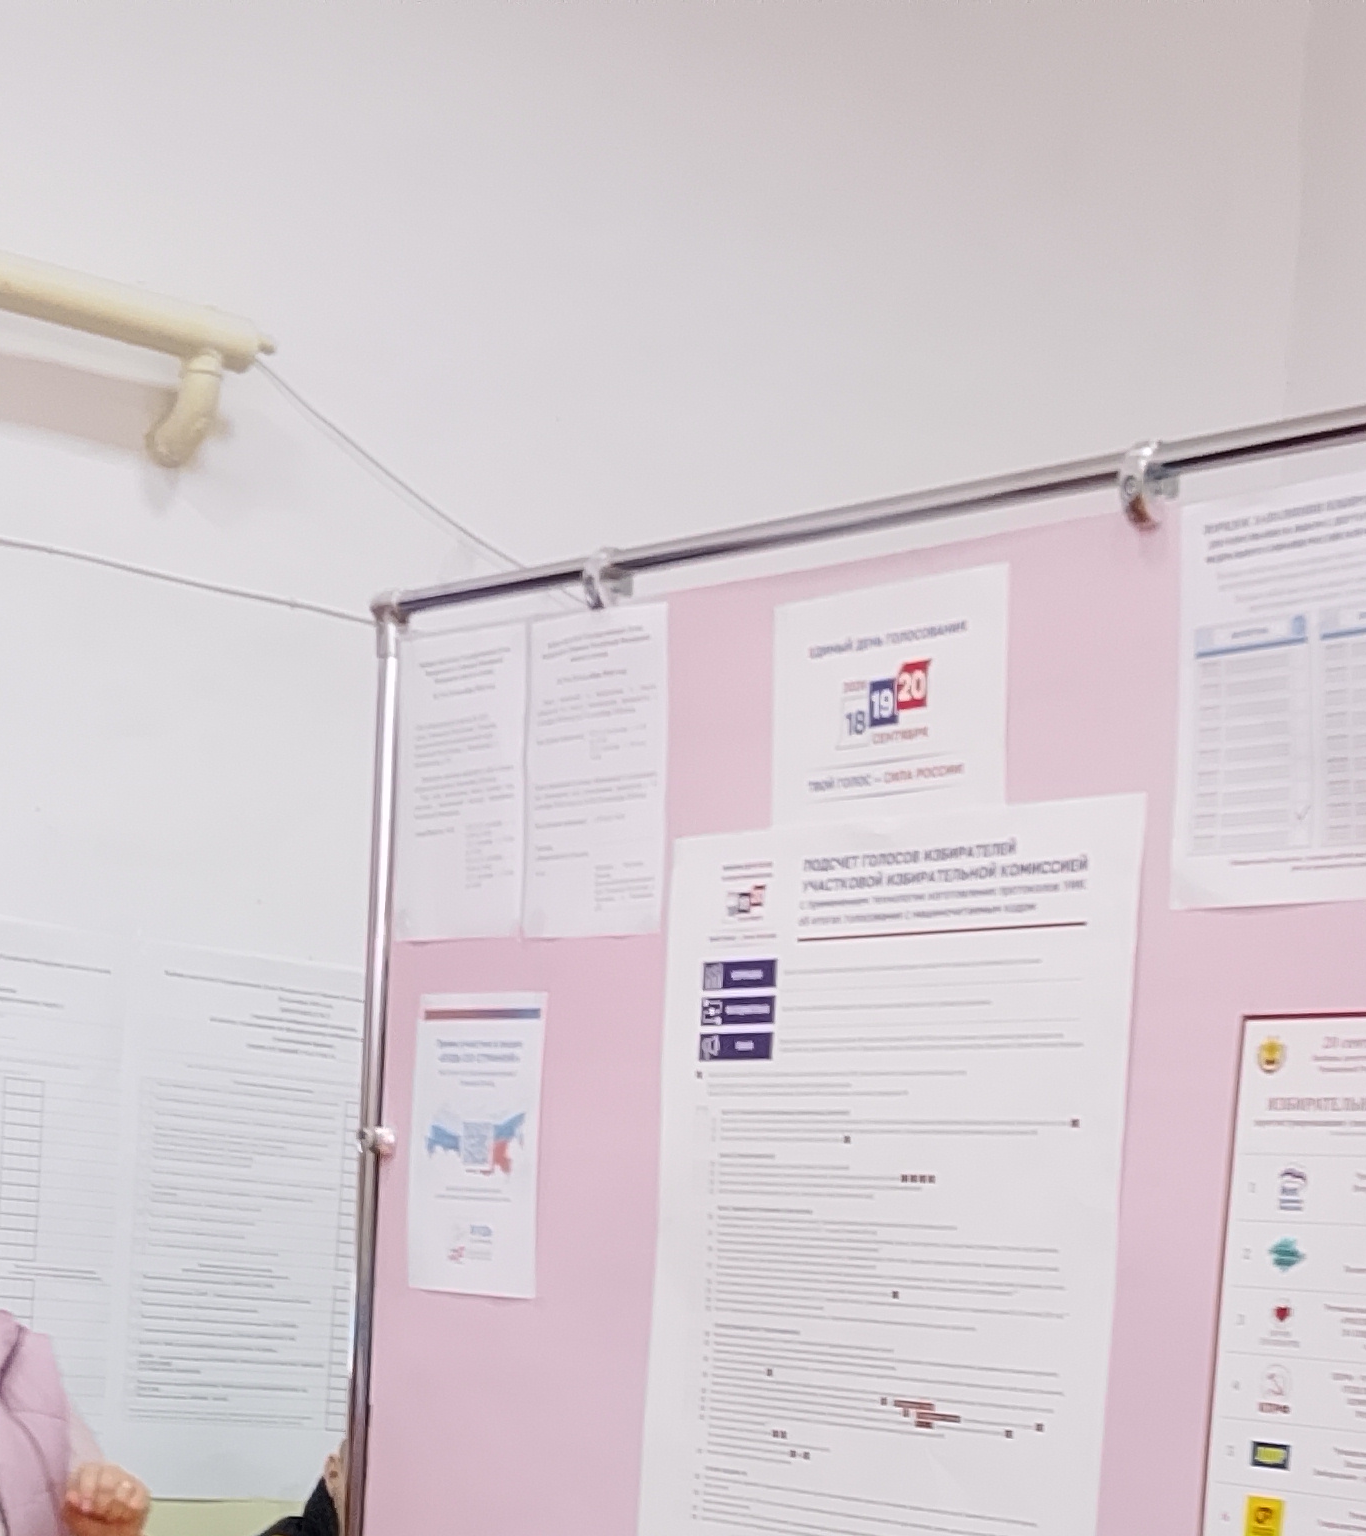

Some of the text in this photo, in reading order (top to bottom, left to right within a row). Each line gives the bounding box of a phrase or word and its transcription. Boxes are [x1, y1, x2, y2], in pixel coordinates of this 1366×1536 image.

[856, 636, 884, 652] ДЕНЬ
[845, 669, 928, 736] 18 19 20
[838, 773, 873, 790] ГОЛОС
[862, 850, 921, 869] ГОЛОСОВ
[923, 837, 1018, 863] ИЗБИРАТЕЛЕЙ
[802, 853, 1088, 893] УЧАСТКОВОЙ ИЗБИРАТЕЛЬНОЙ КОМИССИЕЙ
